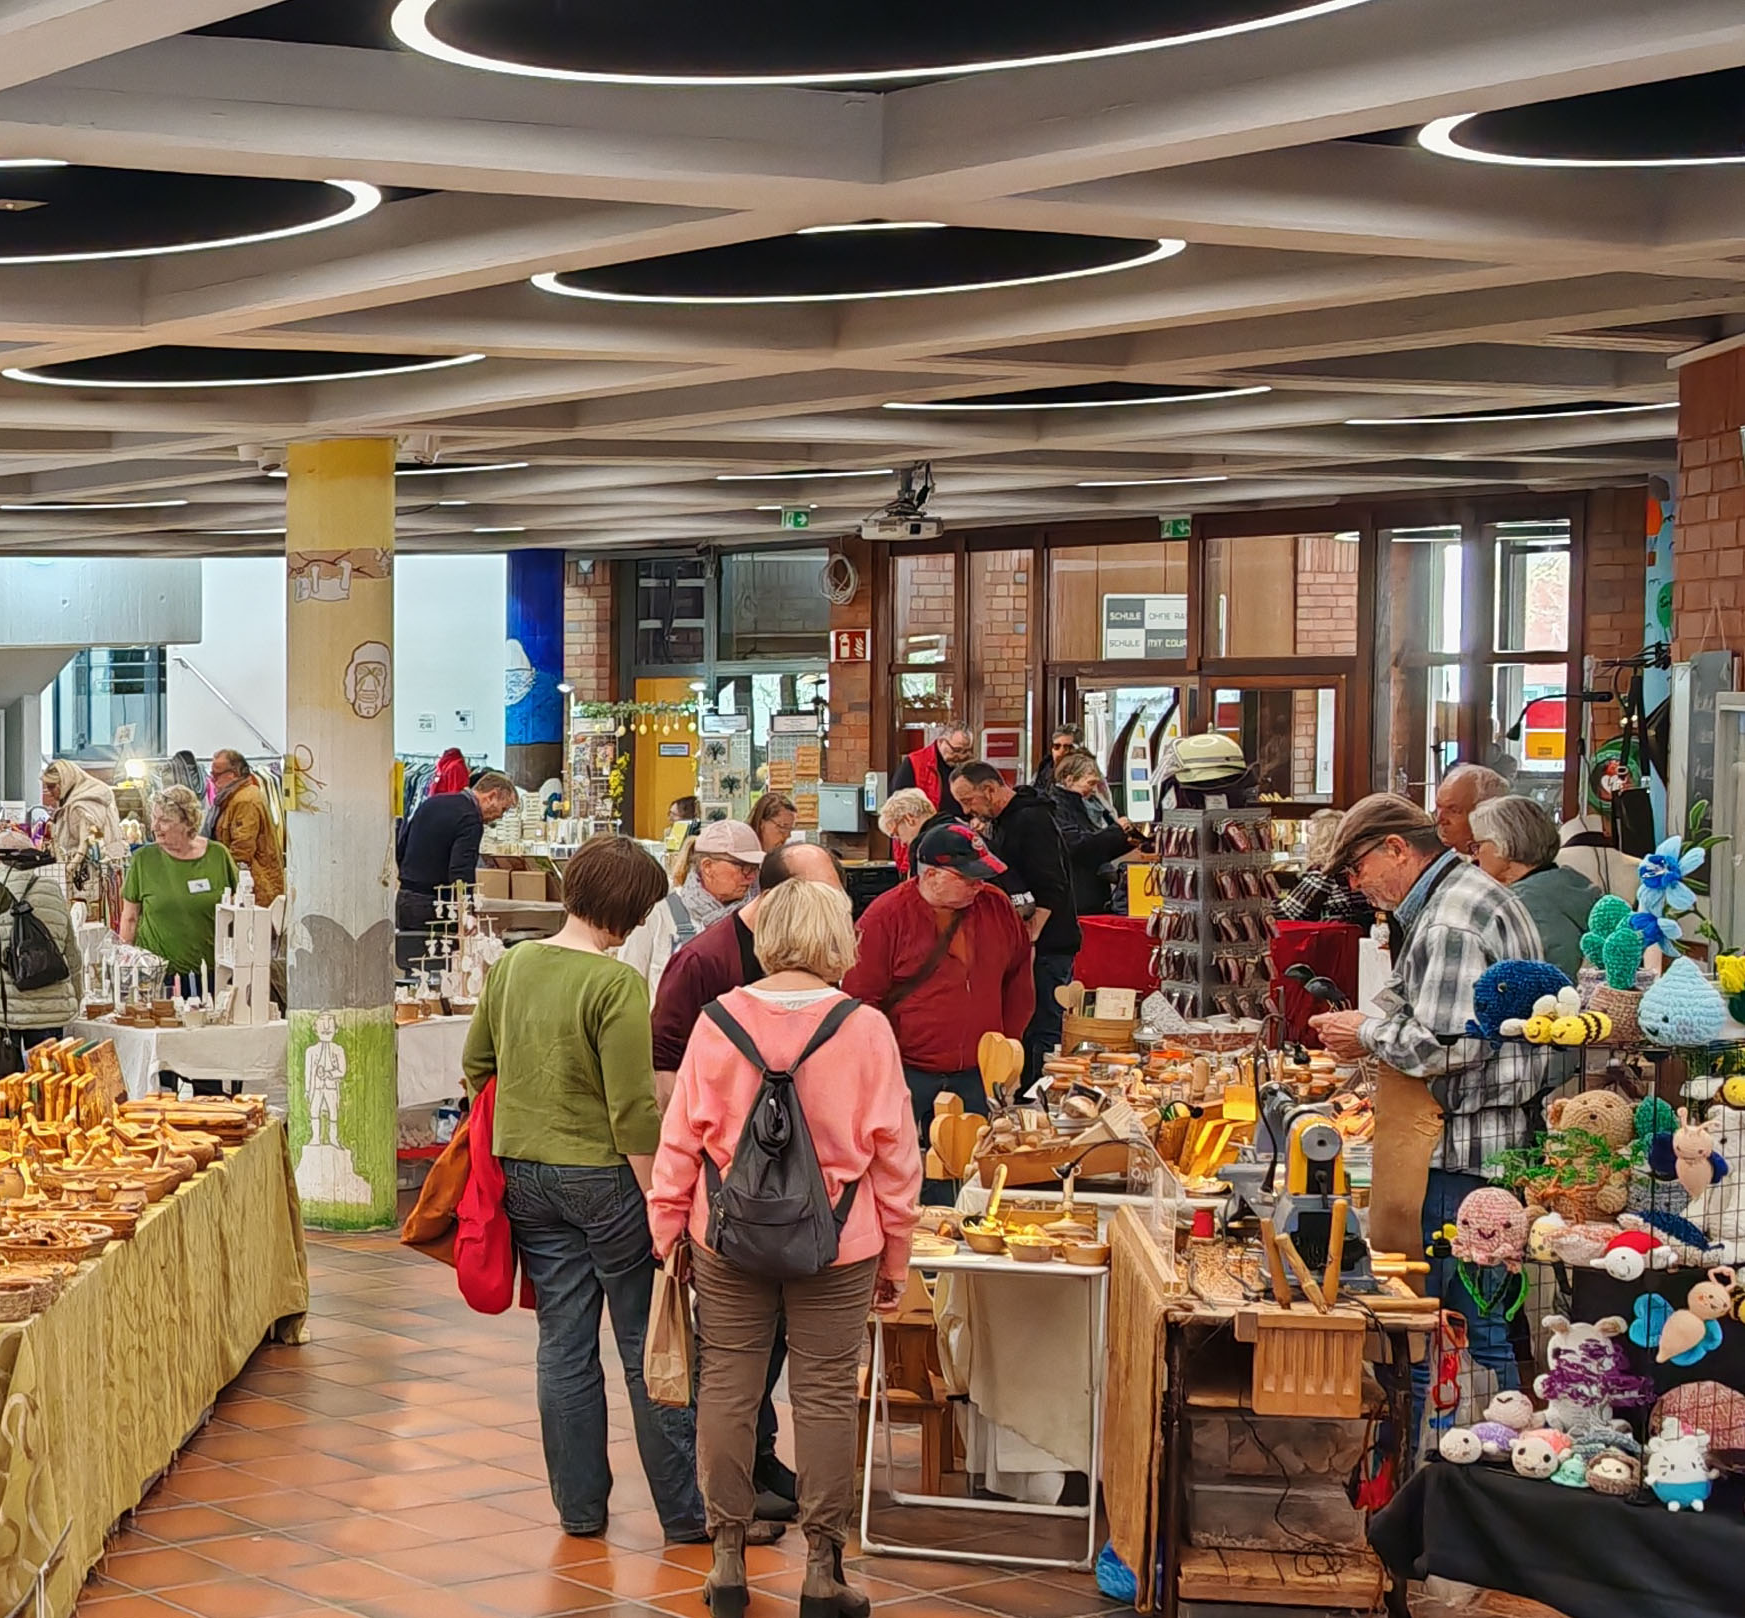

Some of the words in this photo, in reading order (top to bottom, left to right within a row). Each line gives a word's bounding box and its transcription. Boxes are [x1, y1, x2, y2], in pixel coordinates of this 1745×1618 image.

[1109, 611, 1142, 621] SCHULE
[1149, 612, 1171, 621] OHNE
[1109, 639, 1141, 648] SCHULE
[1147, 638, 1164, 648] MIT
